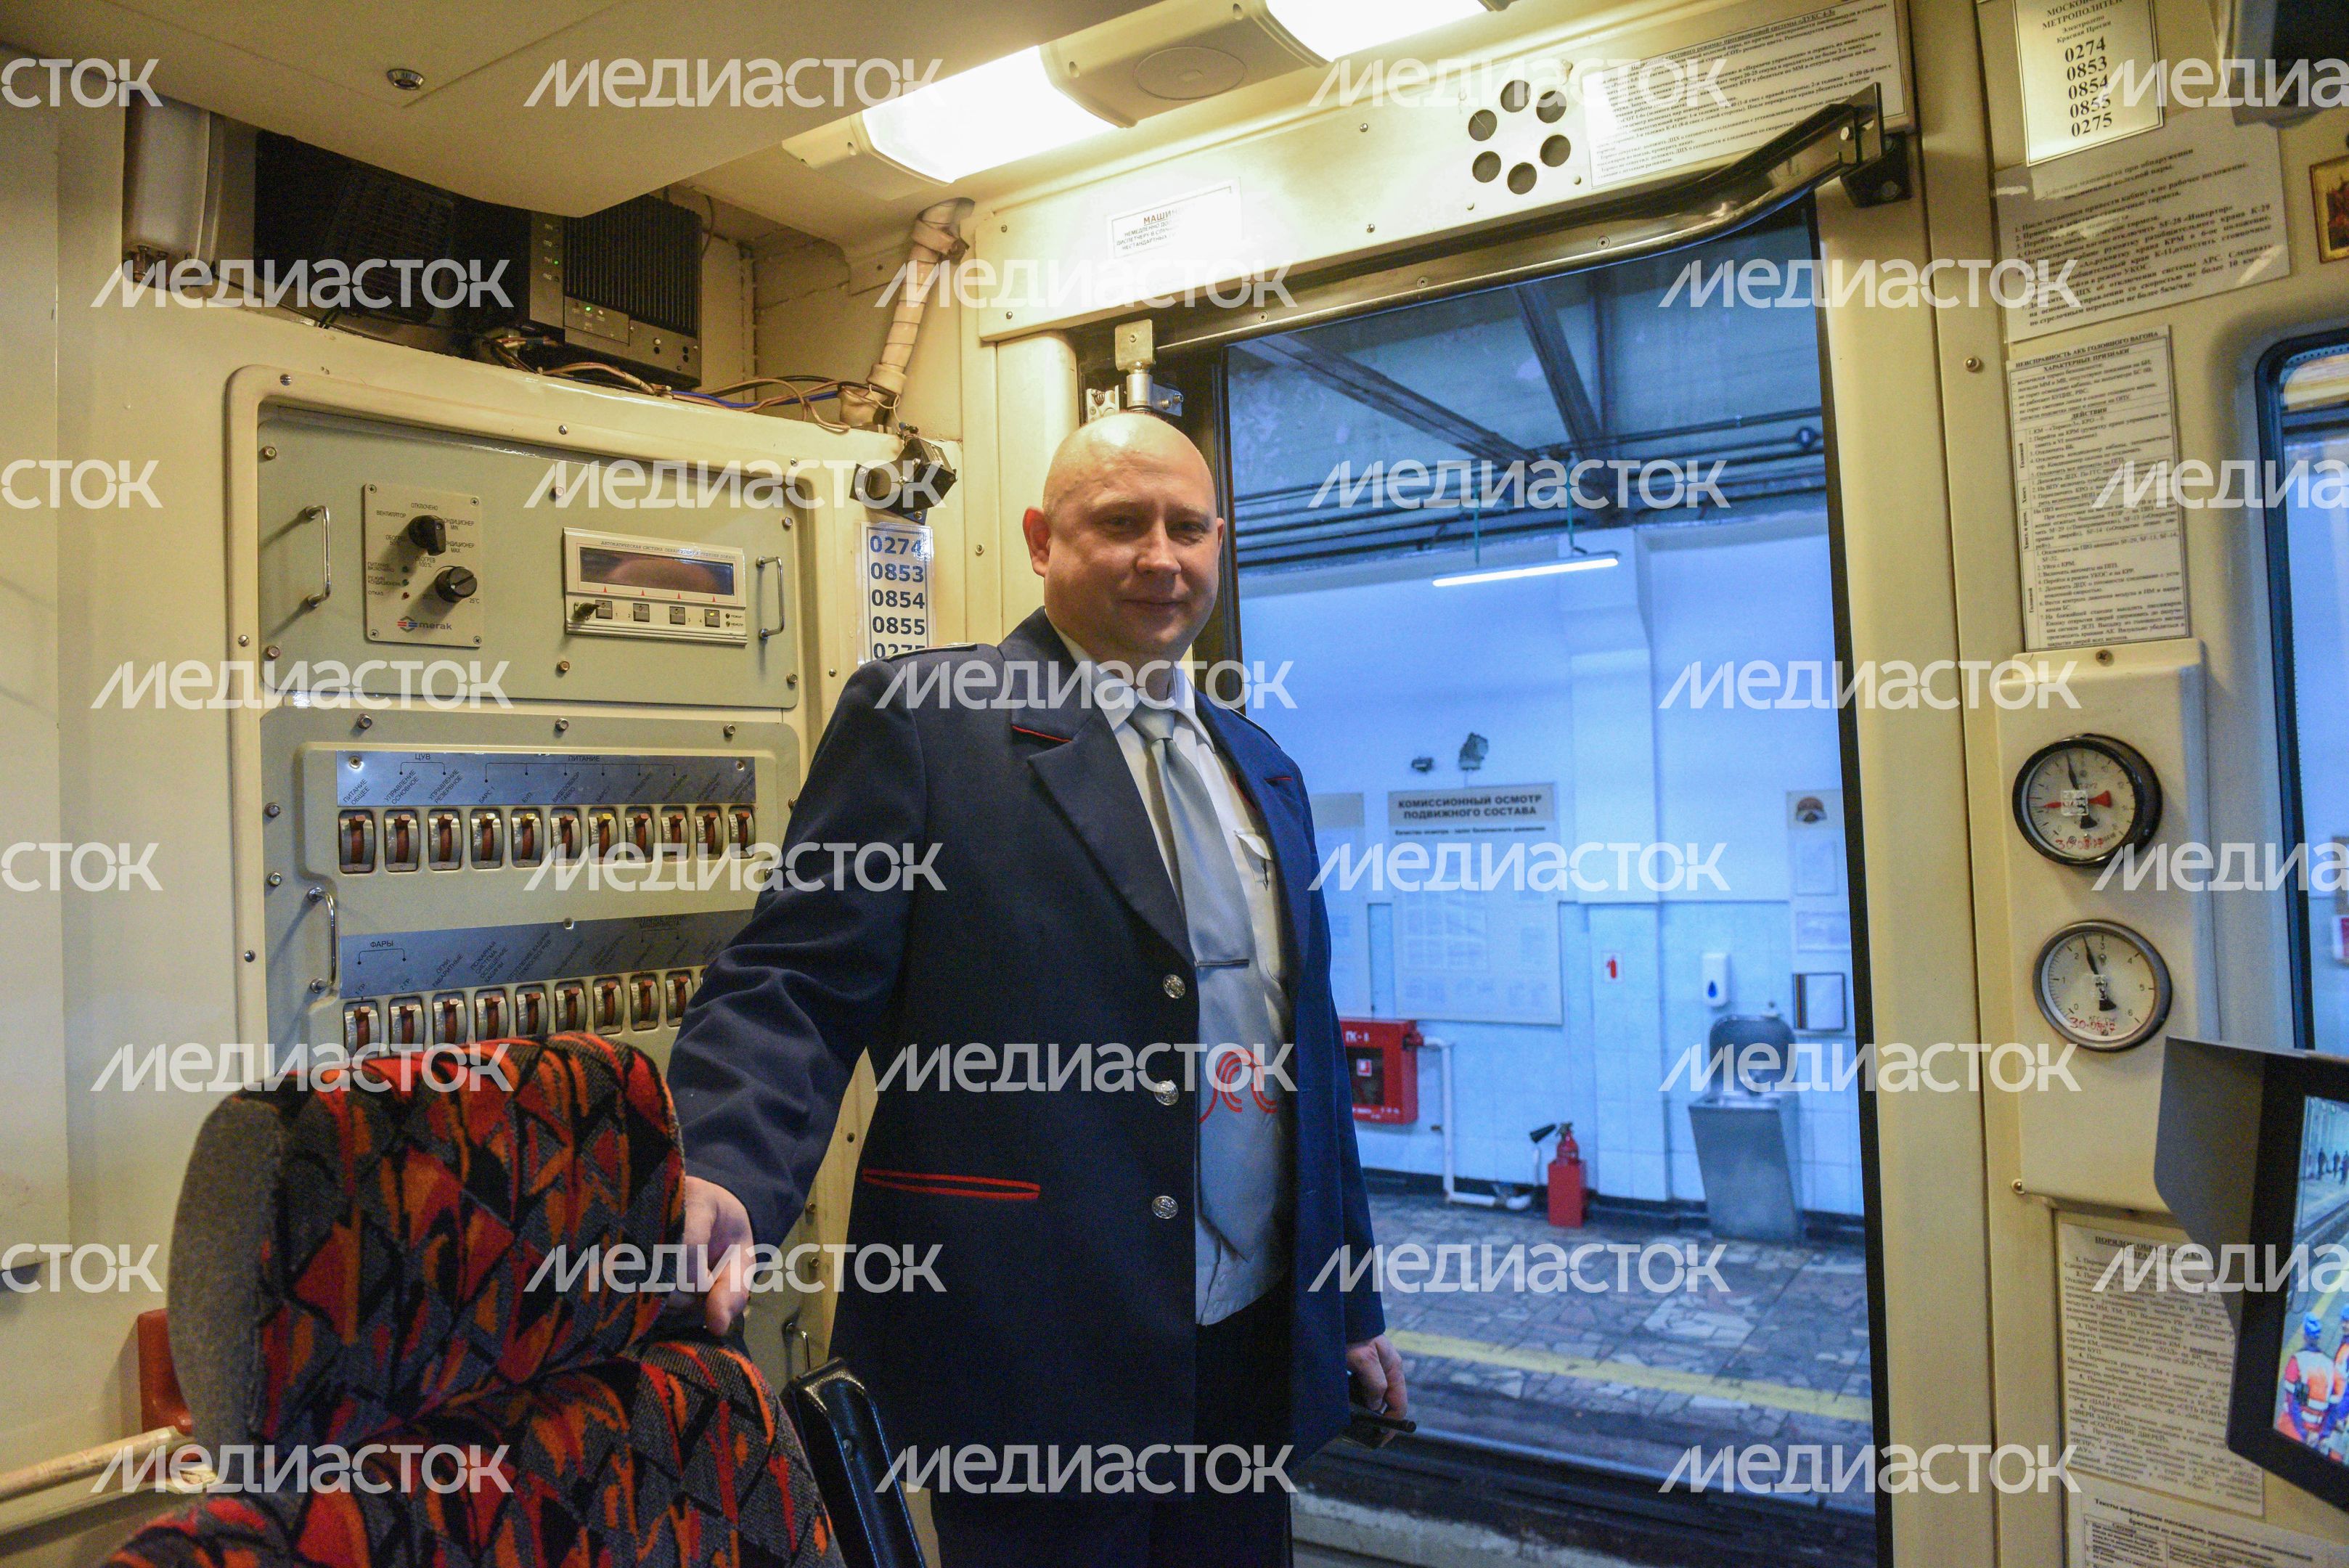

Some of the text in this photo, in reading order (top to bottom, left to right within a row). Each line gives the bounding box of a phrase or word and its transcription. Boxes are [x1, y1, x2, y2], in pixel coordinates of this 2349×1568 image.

[2056, 30, 2085, 44] Красная
[2064, 36, 2106, 62] 0274
[2067, 56, 2107, 81] 0853
[2068, 73, 2108, 99] 0854
[2070, 93, 2111, 118] 0855
[2071, 112, 2112, 137] 0275
[2129, 330, 2158, 342] ВАГОНА
[376, 510, 407, 518] ВЕНТИЛЯТОР
[411, 502, 438, 511] ОТКЛЮЧЕНО
[444, 517, 475, 526] ОНДИЦИОНЕР
[870, 535, 921, 555] 0274
[870, 562, 924, 583] 0853
[871, 589, 926, 609] 0854
[419, 621, 453, 631] merak
[872, 616, 926, 636] 0855
[343, 778, 367, 803] ПИТАНИЕ
[384, 769, 417, 802] УПРАВЛЕНИЕ
[391, 777, 420, 805] ОСНОВНОЕ
[428, 769, 460, 801] УПРАВЛЕНИЕ
[434, 776, 463, 805] РЕЗЕРВНОЕ
[351, 786, 370, 806] ОБЩЕЕ
[1397, 794, 1542, 808] КОМИССИОННЫЙ ОСМОТР
[1403, 806, 1537, 820] ПОДВИЖНОГО СОСТАВА
